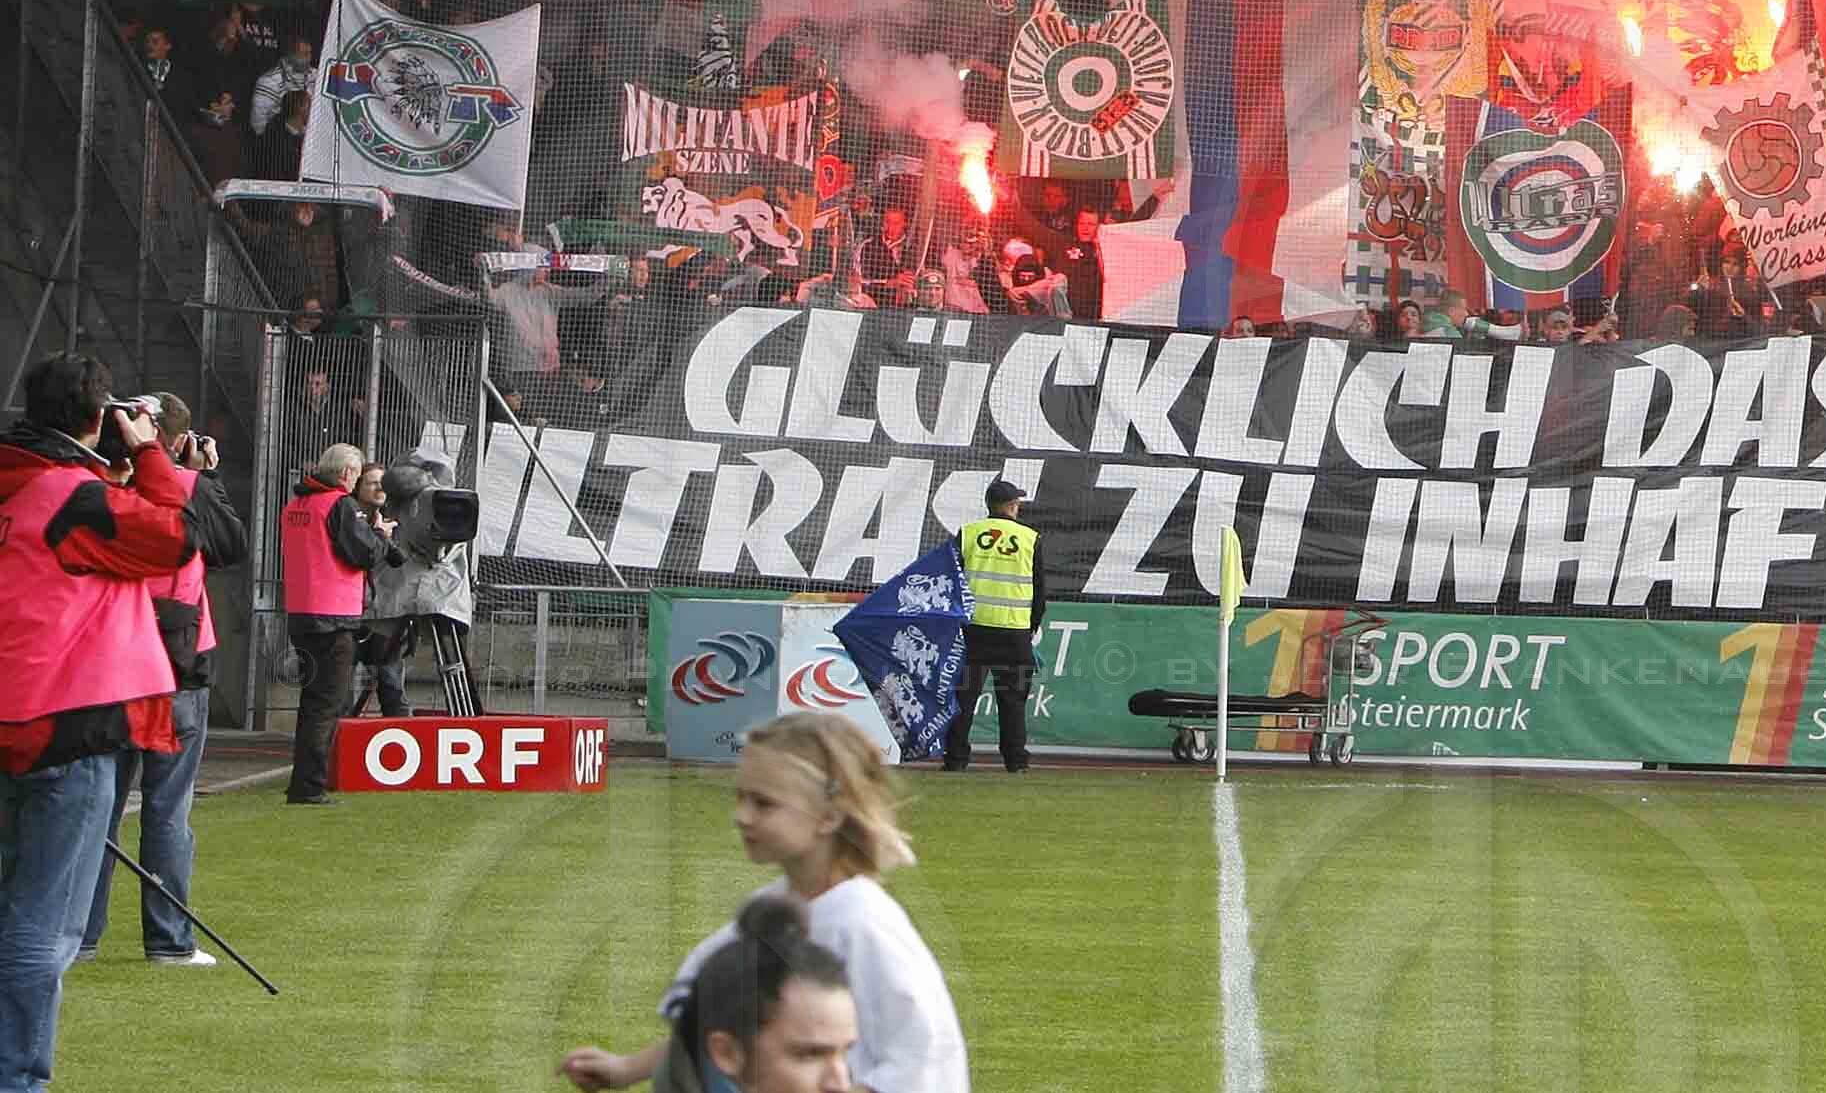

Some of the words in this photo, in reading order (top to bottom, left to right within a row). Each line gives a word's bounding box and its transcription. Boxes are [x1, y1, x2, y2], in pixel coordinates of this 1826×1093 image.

[622, 82, 819, 171] MILITANTE
[675, 150, 750, 176] SZENE
[684, 306, 1555, 471] GLÜCKLICH
[976, 528, 1020, 556] G4S
[1084, 464, 1316, 598] ZU
[1354, 628, 1567, 692] SPORT
[1341, 691, 1531, 732] Steiermark
[364, 727, 545, 786] ORF
[574, 728, 606, 786] ORF
